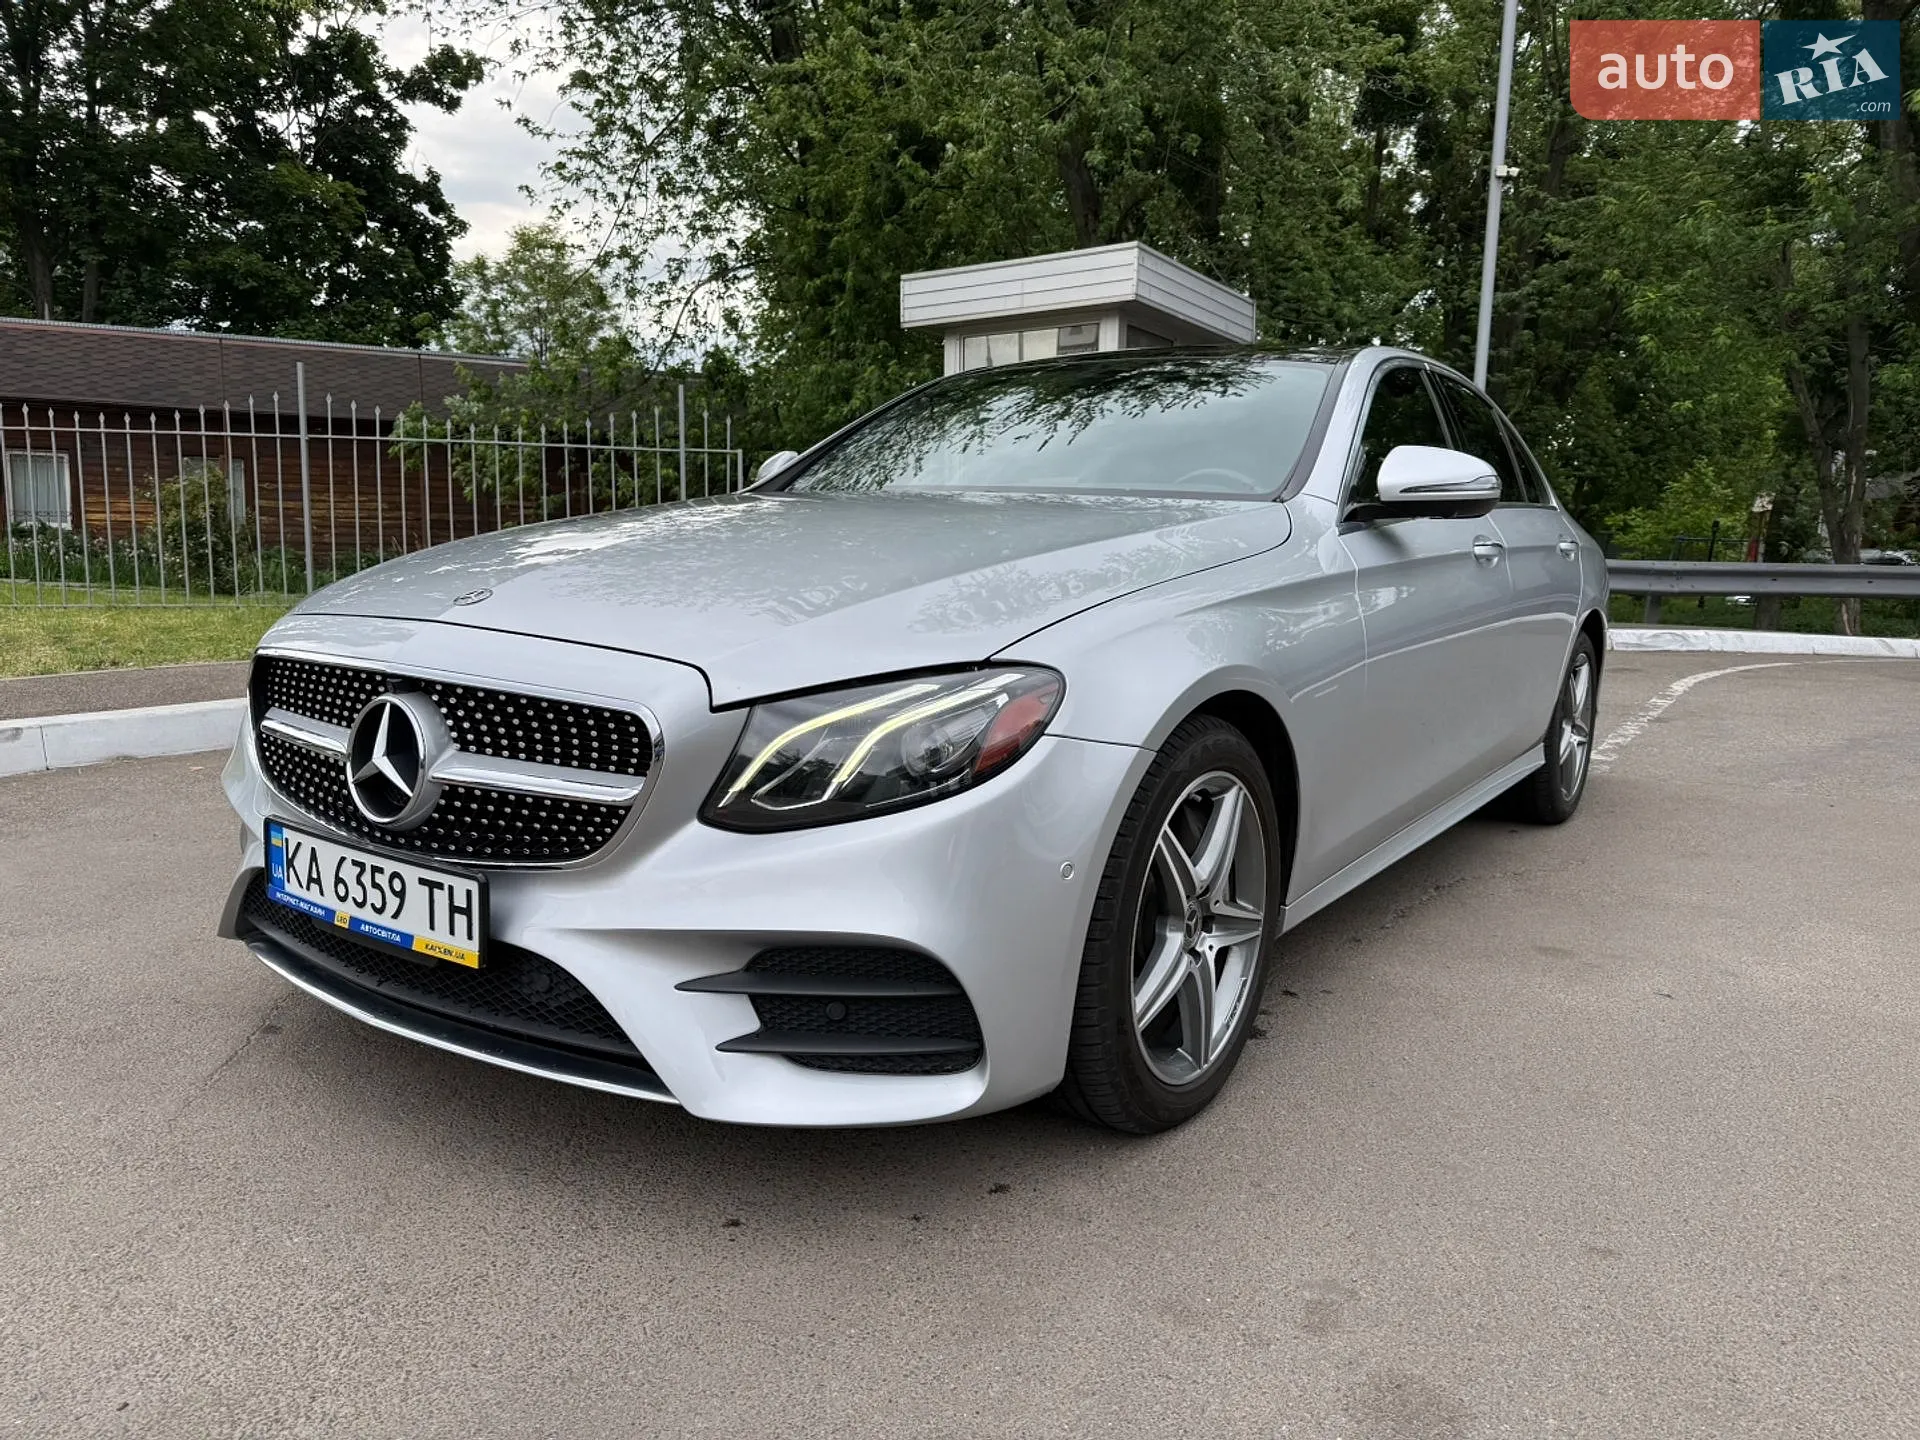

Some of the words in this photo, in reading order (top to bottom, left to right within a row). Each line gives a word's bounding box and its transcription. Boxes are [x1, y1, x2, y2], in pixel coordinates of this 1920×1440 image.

[271, 863, 284, 880] UA
[285, 837, 325, 898] KA
[334, 856, 407, 920] 6359
[418, 877, 473, 941] TH
